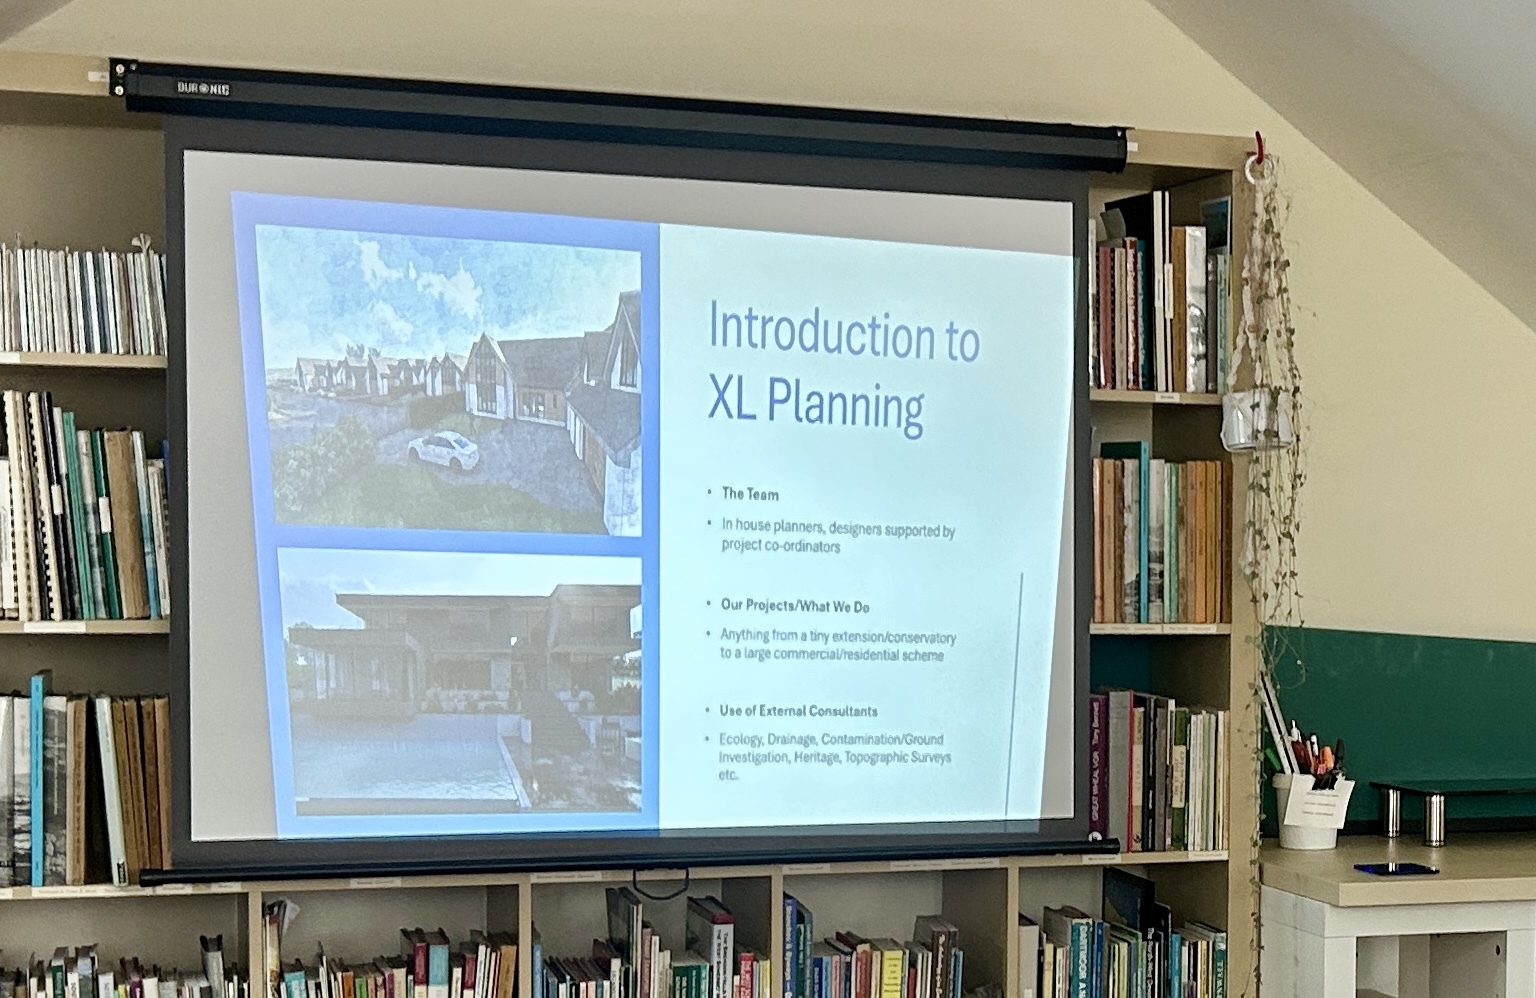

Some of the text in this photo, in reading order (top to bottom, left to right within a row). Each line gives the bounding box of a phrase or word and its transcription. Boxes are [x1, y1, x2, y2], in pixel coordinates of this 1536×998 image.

[710, 299, 980, 362] Introduction to
[708, 373, 925, 440] XL Planning
[722, 486, 779, 502] The Team
[722, 518, 956, 541] In house planners, designers supported by
[722, 538, 841, 554] project co-ordinators
[721, 598, 870, 614] Our Projects/What We Do
[721, 628, 957, 647] Anything from a tiny extension/conservatory
[720, 647, 944, 662] to a large commercial/residential scheme
[719, 705, 878, 718] Use of External Consultants
[719, 733, 943, 748] Ecology, Drainage, Contamination/Ground
[719, 751, 952, 766] Investigation, Heritage, Topographic Surveys
[719, 769, 740, 781] etc.
[1078, 925, 1088, 980] DARTMOOR
[1078, 981, 1087, 990] A
